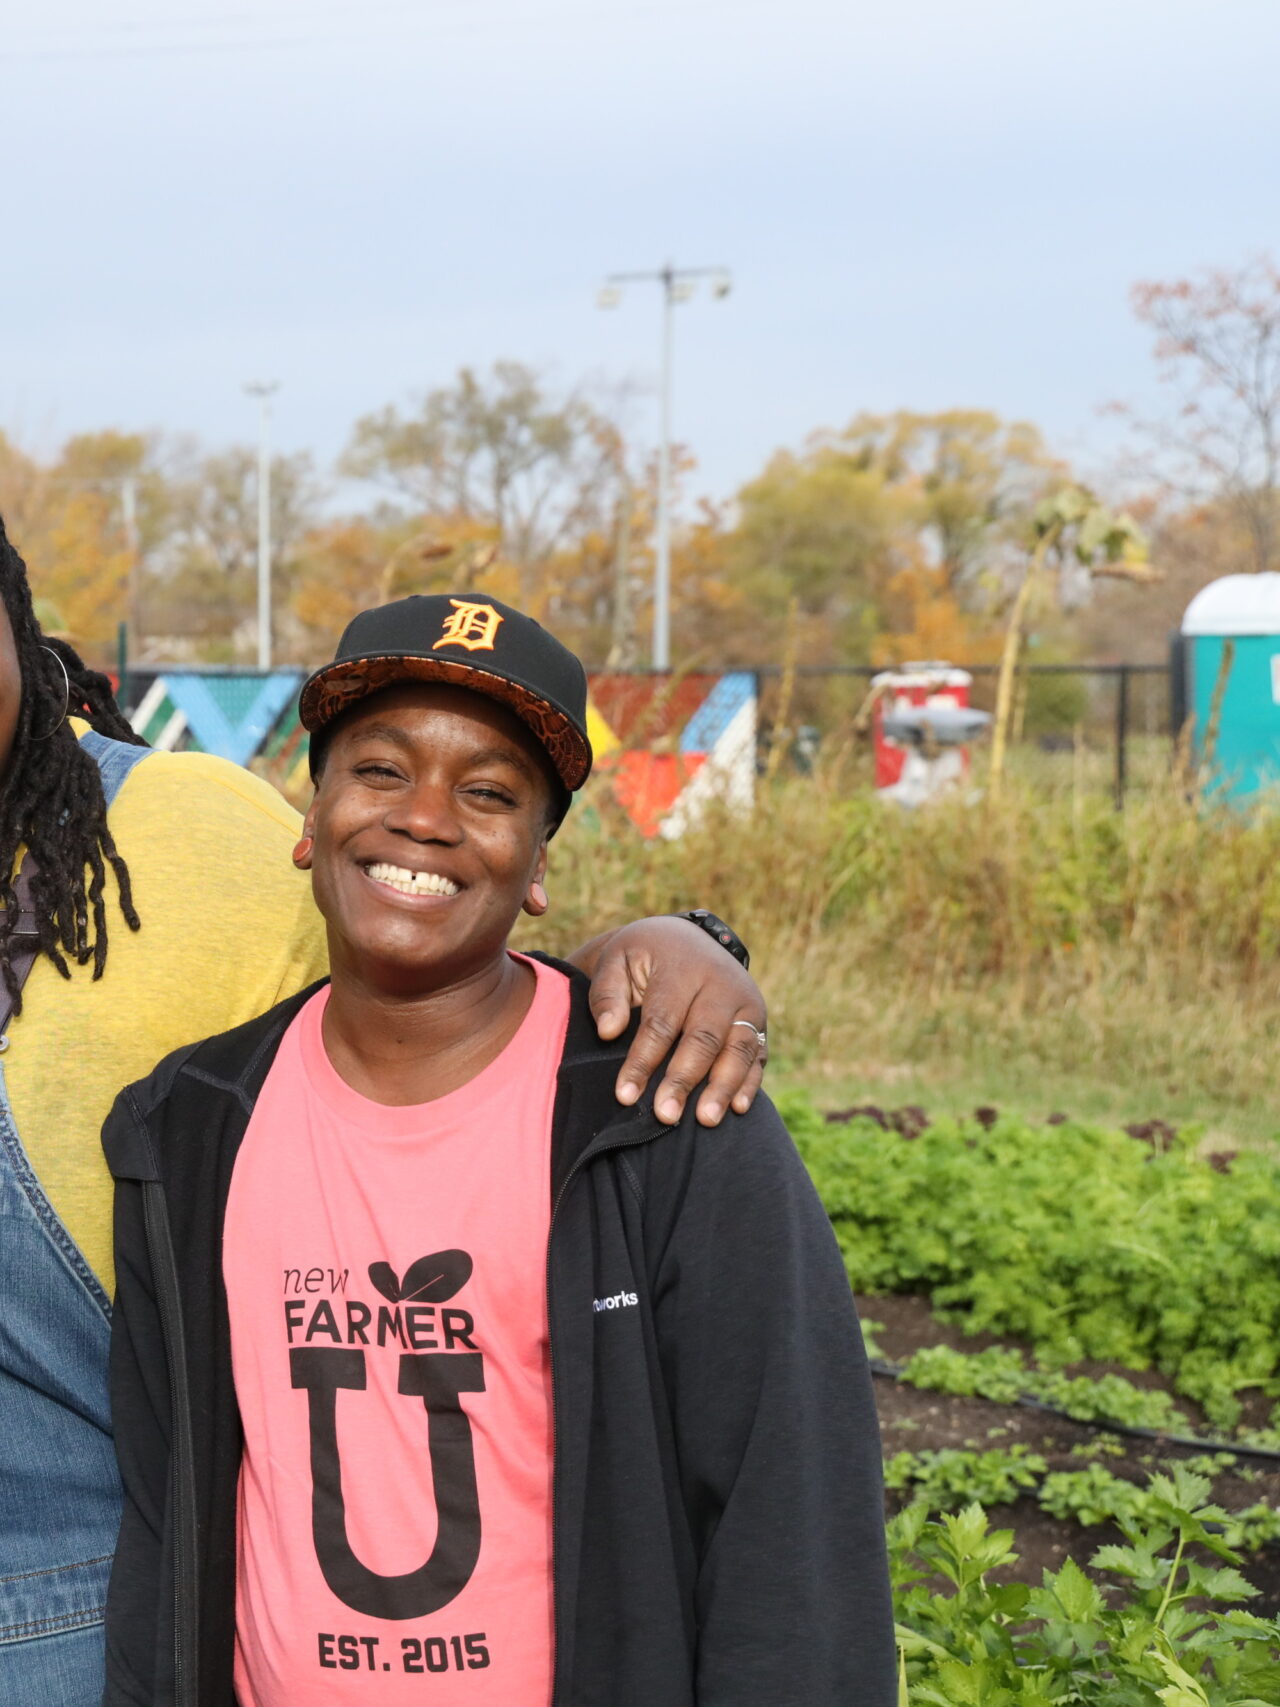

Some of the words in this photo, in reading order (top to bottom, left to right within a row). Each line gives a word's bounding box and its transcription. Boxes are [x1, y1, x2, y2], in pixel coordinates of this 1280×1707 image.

[432, 598, 505, 651] D
[283, 1267, 349, 1294] new
[284, 1299, 479, 1350] FARMER
[289, 1347, 486, 1621] U
[318, 1632, 391, 1671] EST.
[400, 1632, 491, 1673] 2015
